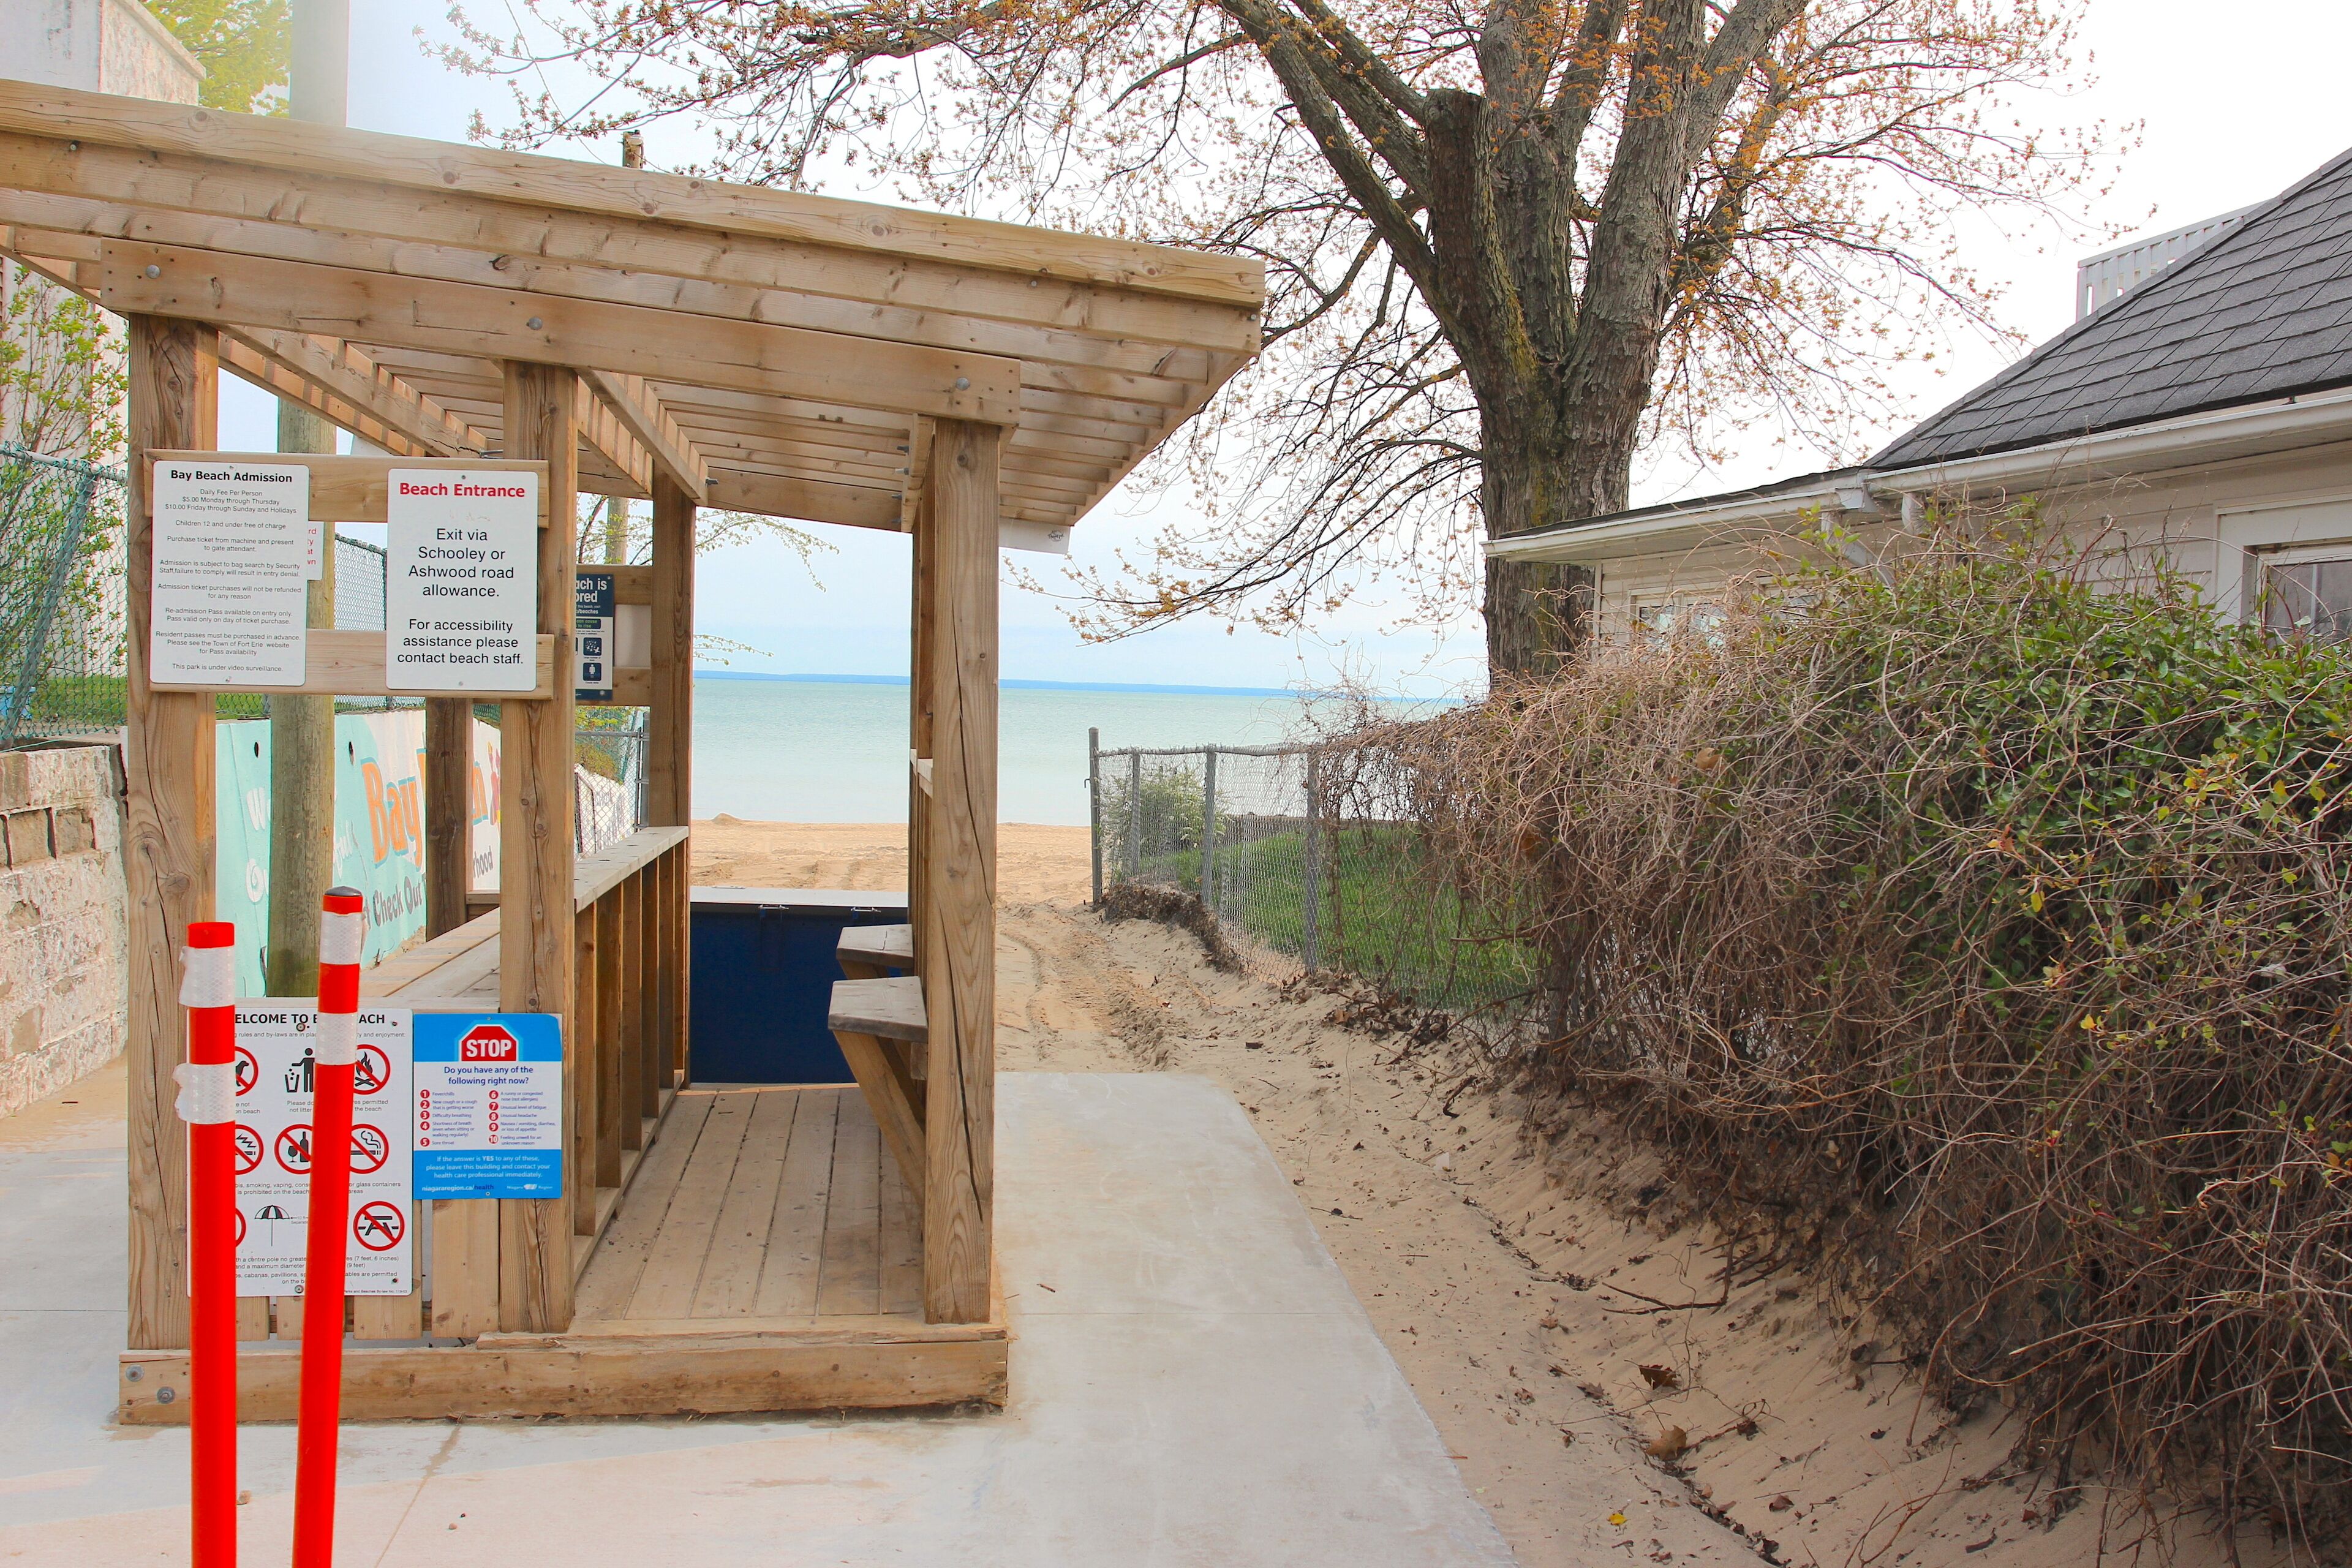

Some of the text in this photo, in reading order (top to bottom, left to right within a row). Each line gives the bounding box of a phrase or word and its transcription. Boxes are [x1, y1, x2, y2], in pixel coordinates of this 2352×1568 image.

[171, 470, 292, 483] Bay Beach Admission
[400, 483, 524, 496] Beach Entrance
[437, 529, 488, 541] Exit via
[418, 547, 505, 562] Schooley or
[409, 565, 514, 578] Ashwood road
[598, 578, 607, 590] is
[423, 585, 500, 597] allowance.
[409, 619, 513, 633] For accessibility
[403, 636, 518, 650] assistance please
[398, 653, 523, 664] contact beach staff.
[360, 756, 423, 872] Bay
[373, 886, 403, 927] Check
[404, 876, 422, 914] Out
[235, 1014, 287, 1023] ELCOME
[291, 1014, 308, 1023] TO
[359, 1014, 384, 1023] ACH
[466, 1039, 511, 1057] STOP
[448, 1077, 485, 1085] following
[488, 1077, 506, 1085] right
